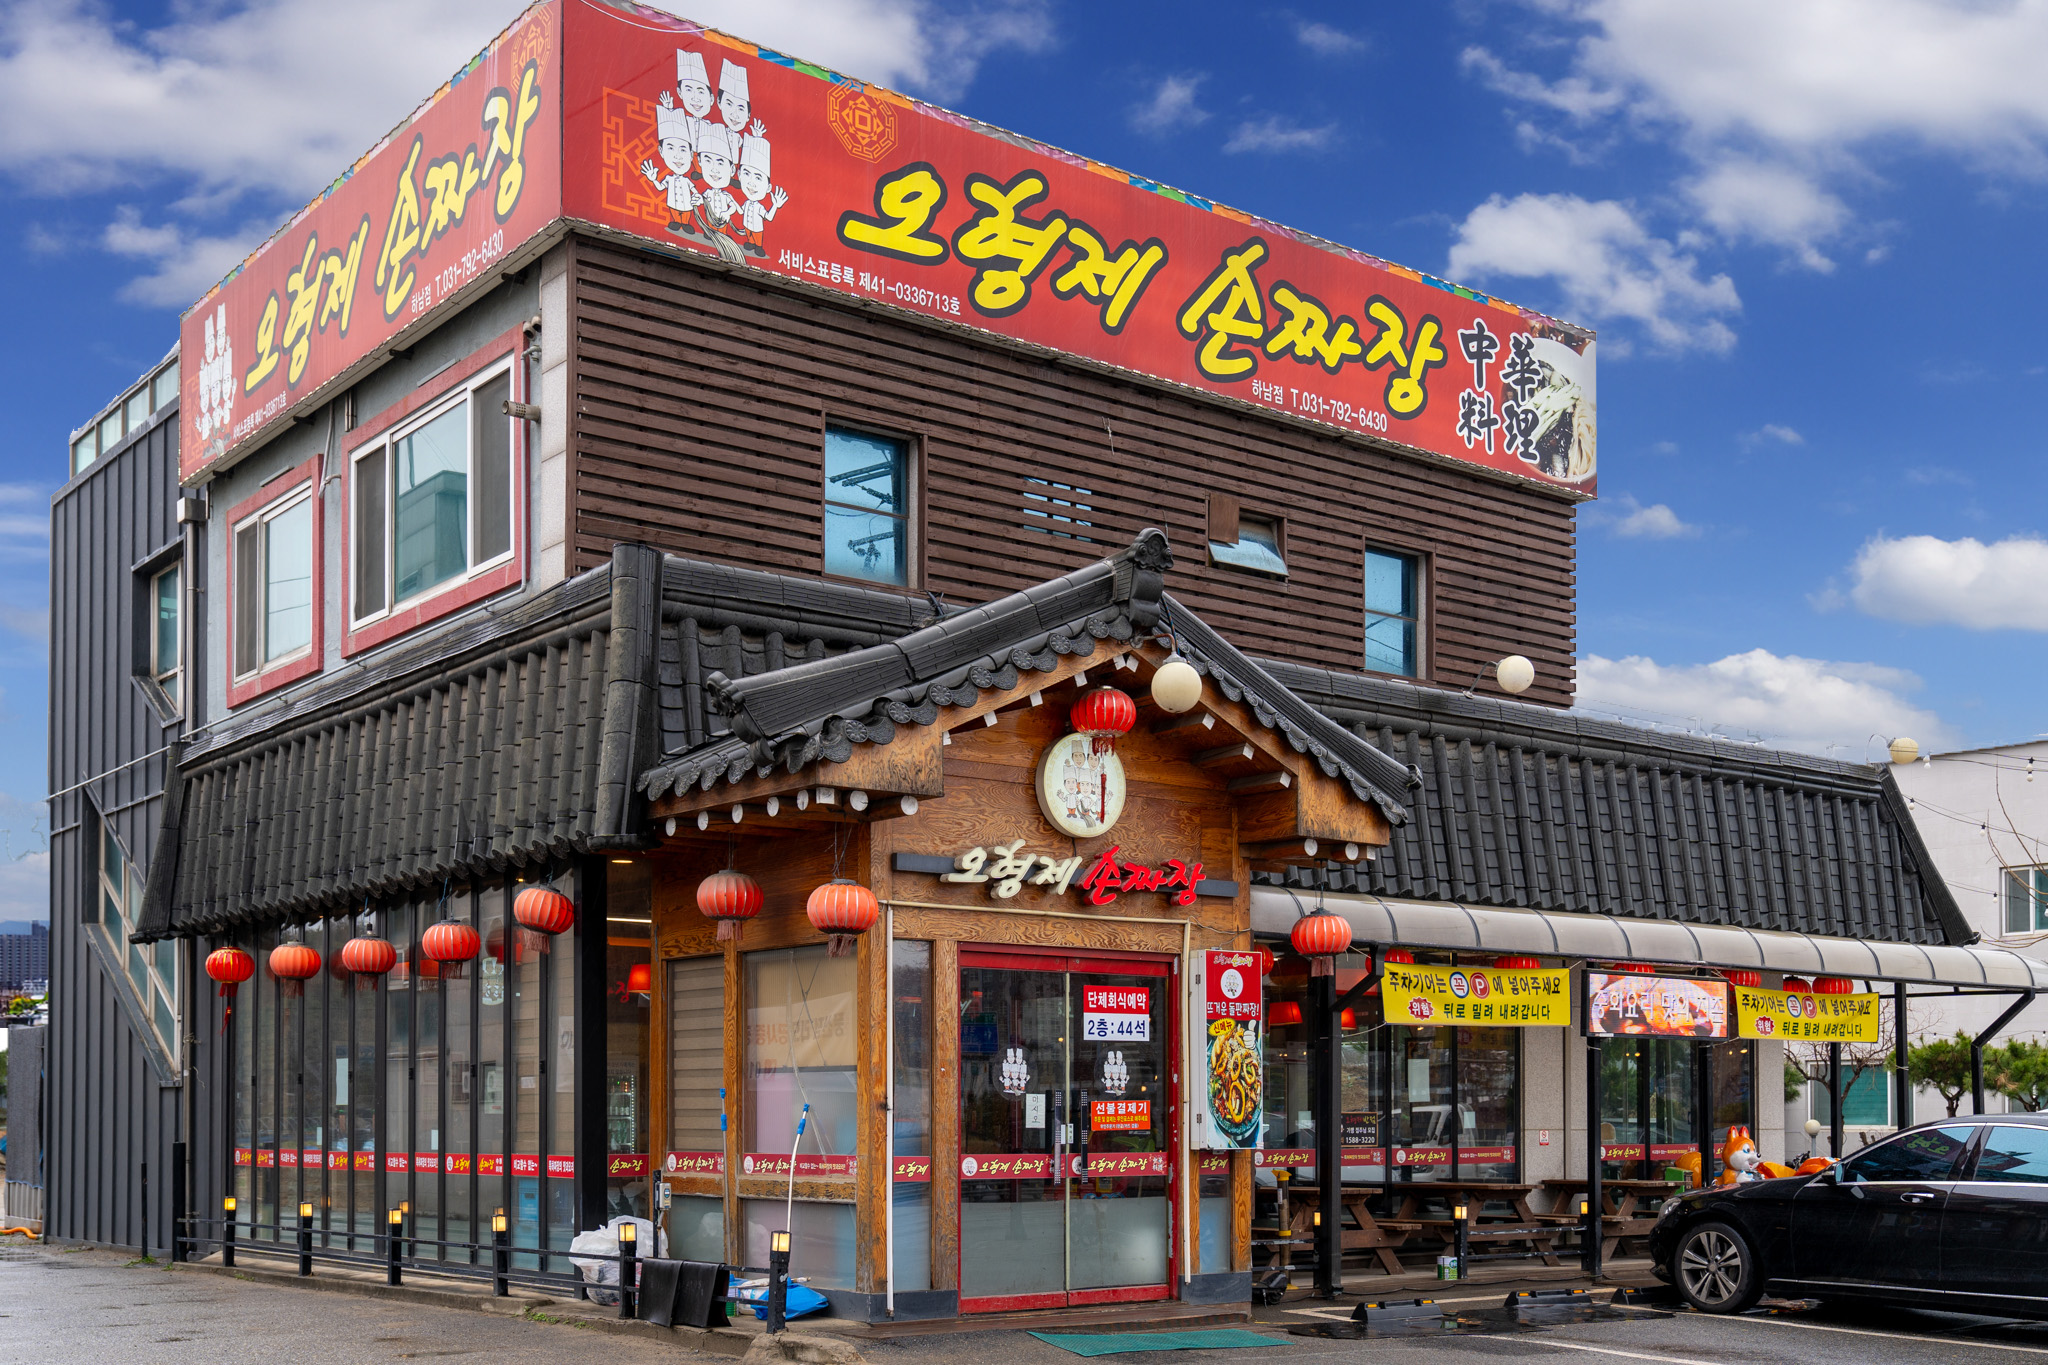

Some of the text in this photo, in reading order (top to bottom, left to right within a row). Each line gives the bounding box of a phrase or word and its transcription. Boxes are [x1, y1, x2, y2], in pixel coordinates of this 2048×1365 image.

[245, 63, 540, 393] 오형제 손짜장
[411, 228, 503, 313] 하남점 T.031-792-6430
[778, 248, 962, 316] 서비스표등록 제41-0336713호
[840, 166, 1446, 416] 오형제 손짜장
[1251, 378, 1388, 433] 하남점 T.031-792-6430
[941, 838, 1206, 906] 오형제 손짜장
[1389, 971, 1561, 996] 주차기어는 꼭 P 에 넣어주세요
[1087, 991, 1147, 1010] 단체회식예약
[1207, 1001, 1260, 1017] 뜨거운 돌판짜장!
[1741, 994, 1786, 1013] 주차기어는
[1805, 1000, 1813, 1014] P
[1819, 998, 1828, 1015] 에
[1830, 998, 1872, 1016] 넣어주세요
[1411, 1001, 1550, 1020] 위험 뒤로 밀려 내려갑니다
[1213, 1020, 1233, 1034] 신메뉴
[1757, 1019, 1863, 1037] 위험 뒤로 밀려 내려갑니다
[609, 1158, 643, 1174] 손짜장
[676, 1156, 695, 1171] 오형제
[695, 1155, 715, 1171] 손짜장
[754, 1158, 774, 1173] 오형제
[979, 1157, 1044, 1174] 오형제 손짜장
[1088, 1157, 1117, 1173] 오형제
[1118, 1156, 1148, 1173] 손짜장
[1200, 1156, 1229, 1171] 오형제
[1265, 1152, 1309, 1165] 오형제 손짜장
[895, 1161, 929, 1178] 오형제
